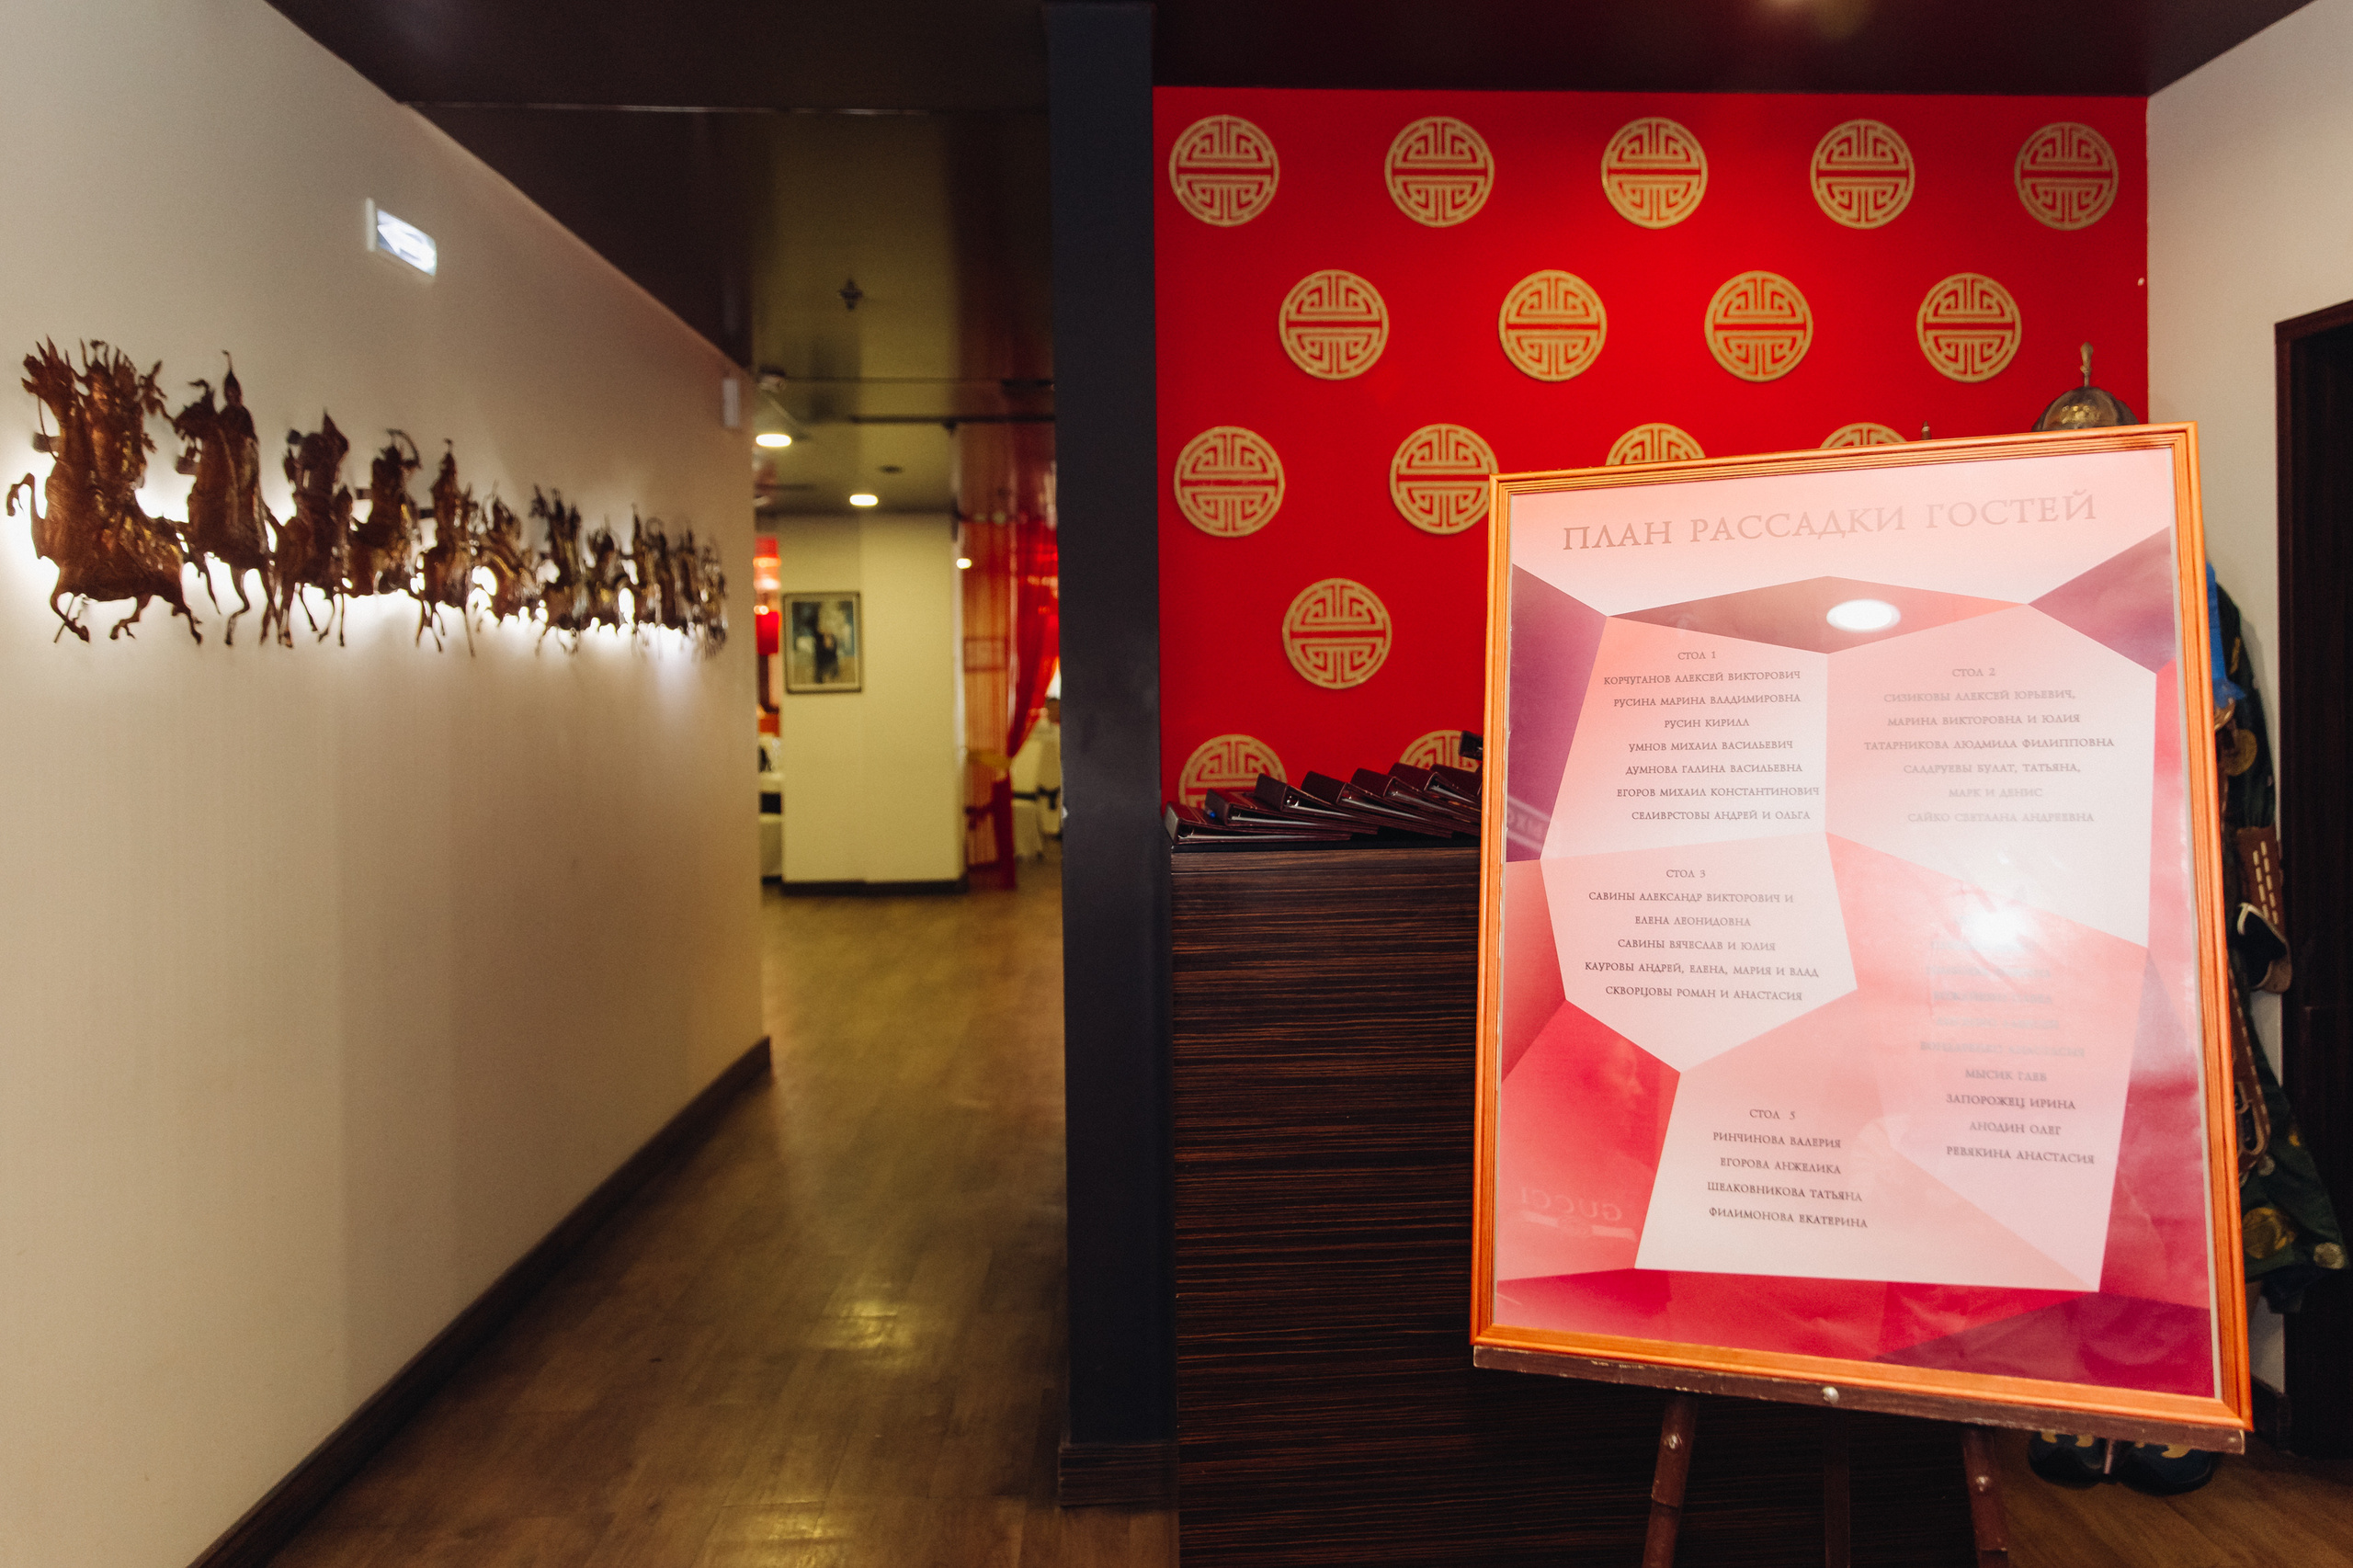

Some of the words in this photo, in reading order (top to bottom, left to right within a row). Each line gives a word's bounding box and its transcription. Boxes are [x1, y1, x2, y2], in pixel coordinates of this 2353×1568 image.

[1563, 521, 1671, 550] ПЛАН
[1690, 506, 1905, 542] РАССАДКИ
[1927, 489, 2097, 528] ГОСТЕЙ
[1677, 652, 1706, 660] СТОЛ
[1711, 651, 1715, 659] 1
[1952, 668, 1984, 676] СТОЛ
[1989, 667, 1995, 676] 2
[1604, 676, 1670, 685] КОРЧУГАНОВ
[1675, 672, 1723, 682] АЛЕКСЕЙ
[1728, 671, 1800, 681] ВИКТОРОВИЧ
[1614, 699, 1656, 708] РУСИНА
[1660, 697, 1705, 705] МАРИНА
[1711, 694, 1801, 704] ВЛАДИМИРОВНА
[1883, 693, 1949, 702] СИЗИКОВЫ
[1955, 690, 2009, 700] АЛЕКСЕЙ
[2015, 689, 2075, 699] ЮРЬЕВИЧ,
[1665, 720, 1700, 729] РУСИН
[1706, 719, 1749, 727] КИРИЛЛ
[1888, 717, 1938, 726] МАРИНА
[1943, 716, 2022, 725] ВИКТОРОВНА
[2028, 715, 2037, 723] И
[2042, 714, 2080, 722] ЮЛИЯ
[1629, 744, 1666, 753] УМНОВ
[1722, 741, 1792, 749] ВАСИЛЬЕВИЧ
[1864, 741, 1949, 750] ТАТАРНИКОВА
[1954, 740, 2018, 749] ЛЮДМИЛА
[2022, 738, 2114, 748] ФИЛИППОВНА
[1626, 766, 1677, 775] ДУМНОВА
[1731, 764, 1802, 772] ВАСИЛЬЕВНА
[1978, 764, 2018, 774] БУЛАТ,
[2022, 764, 2081, 773] ТАТЬЯНА,
[1617, 789, 1655, 797] ЕГОРОВ
[1711, 788, 1819, 796] КОНСТАНТИНОВИЧ
[1949, 789, 1981, 797] МАРК
[1985, 789, 1995, 797] И
[1999, 788, 2042, 798] ДЕНИС
[1631, 812, 1710, 820] СЕЛИВРСТОВЫ
[1714, 810, 1757, 820] АНДРЕЙ
[1775, 811, 1810, 819] ОЛЬГА
[1907, 812, 1950, 822] САЙКО
[1955, 813, 2018, 822] СВЕТЛАНА
[1666, 869, 1695, 878] СТОЛ
[1700, 869, 1706, 878] 3
[1588, 892, 1634, 901] САВИНЫ
[1640, 893, 1702, 902] АЛЕКСАНДР
[1707, 893, 1779, 903] ВИКТОРОВИЧ
[1785, 894, 1793, 903] И
[1635, 916, 1669, 925] ЕЛЕНА
[1674, 917, 1751, 926] ЛЕОНИДОВНА
[1618, 939, 1665, 948] САВИНЫ
[1670, 940, 1722, 949] ВЯЧЕСЛАВ
[1741, 942, 1775, 951] ЮЛИЯ
[1586, 962, 1633, 971] КАУРОВЫ
[1639, 963, 1684, 973] АНДРЕЙ,
[1690, 965, 1727, 974] ЕЛЕНА,
[1733, 966, 1771, 975] МАРИЯ
[1777, 967, 1784, 975] И
[1790, 968, 1819, 978] ВЛАД
[1606, 986, 1672, 997] СКВОРЦОВЫ
[1677, 988, 1715, 997] РОМАН
[1721, 990, 1729, 998] И
[1733, 991, 1802, 1001] АНАСТАСИЯ
[1965, 1069, 2013, 1079] МЫСИК
[2018, 1072, 2047, 1082] ГЛЕБ
[1947, 1094, 2025, 1108] ЗАПОРОЖЕЦ
[2030, 1098, 2075, 1109] ИРИНА
[1749, 1109, 1779, 1119] СТОЛ
[1790, 1111, 1795, 1119] 5
[1970, 1122, 2025, 1133] АНОДИН
[2029, 1125, 2061, 1135] ОЛЕГ
[1713, 1131, 1785, 1144] РИНЧИНОВА
[1790, 1137, 1841, 1148] ВАЛЕРИЯ
[1947, 1146, 2011, 1159] РЕВЯКИНА
[2017, 1151, 2095, 1165] АНАСТАСИЯ
[1721, 1157, 1769, 1169] ЕГОРОВА
[1775, 1162, 1841, 1174] АНЖЕЛИКА
[1708, 1182, 1805, 1197] ШЕЛКОВНИКОВА
[1810, 1189, 1862, 1201] ТАТЬЯНА
[1709, 1207, 1794, 1222] ФИЛИМОНОВА
[1800, 1214, 1868, 1228] ЕКАТЕРИНА
